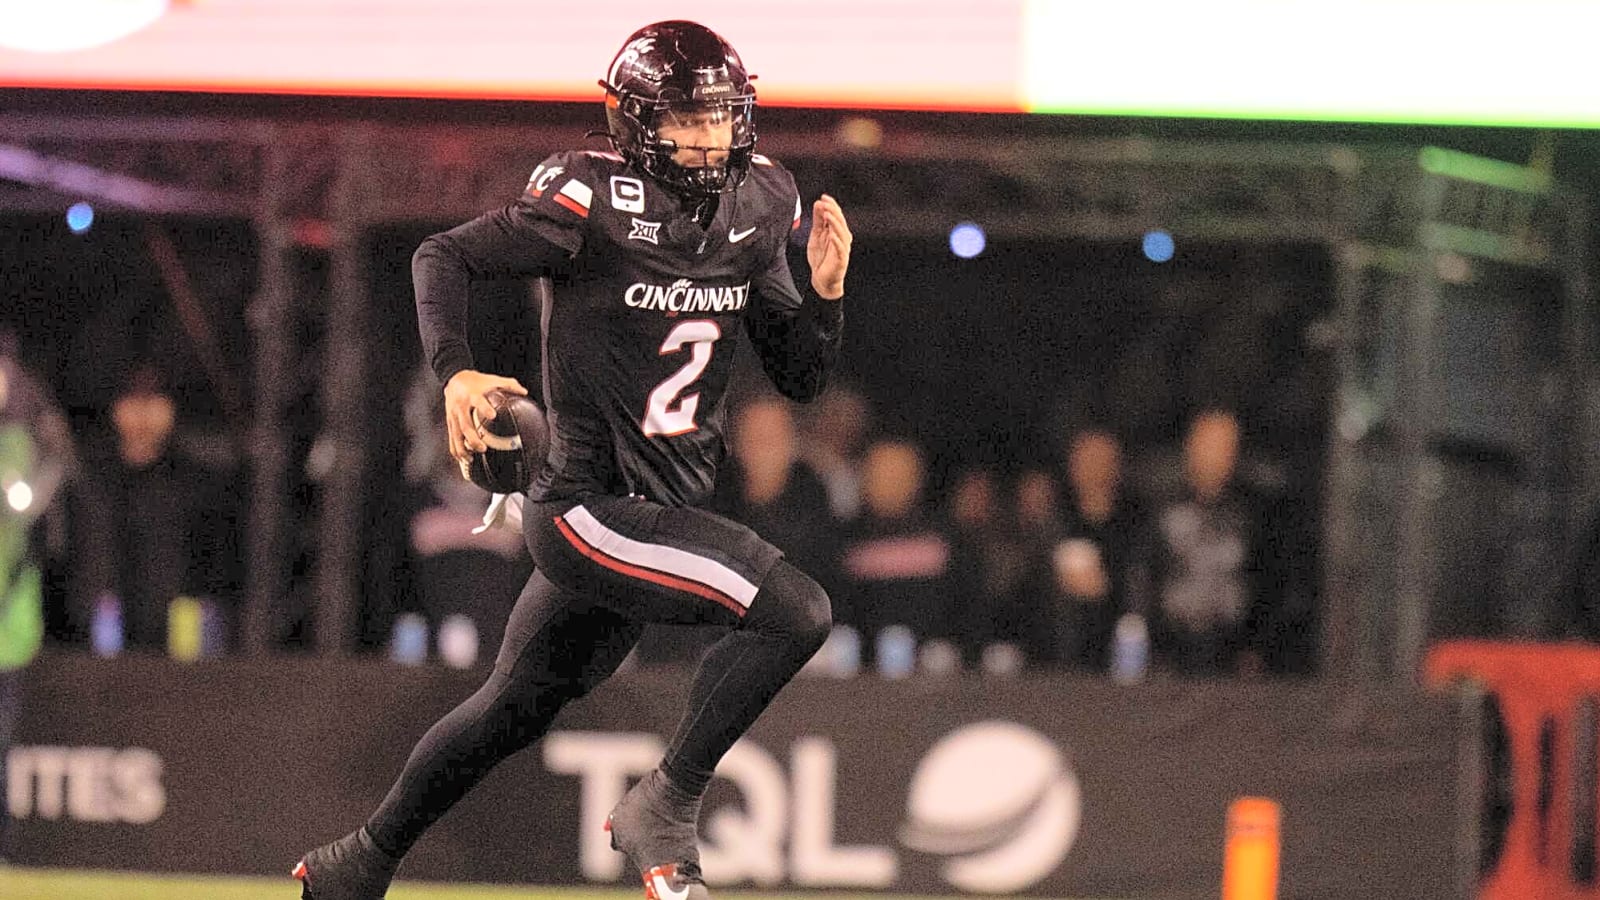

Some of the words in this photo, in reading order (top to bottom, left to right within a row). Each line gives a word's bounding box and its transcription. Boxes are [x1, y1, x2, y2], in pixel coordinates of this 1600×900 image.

[613, 180, 641, 202] C
[642, 319, 721, 438] 2
[544, 731, 895, 886] TQL
